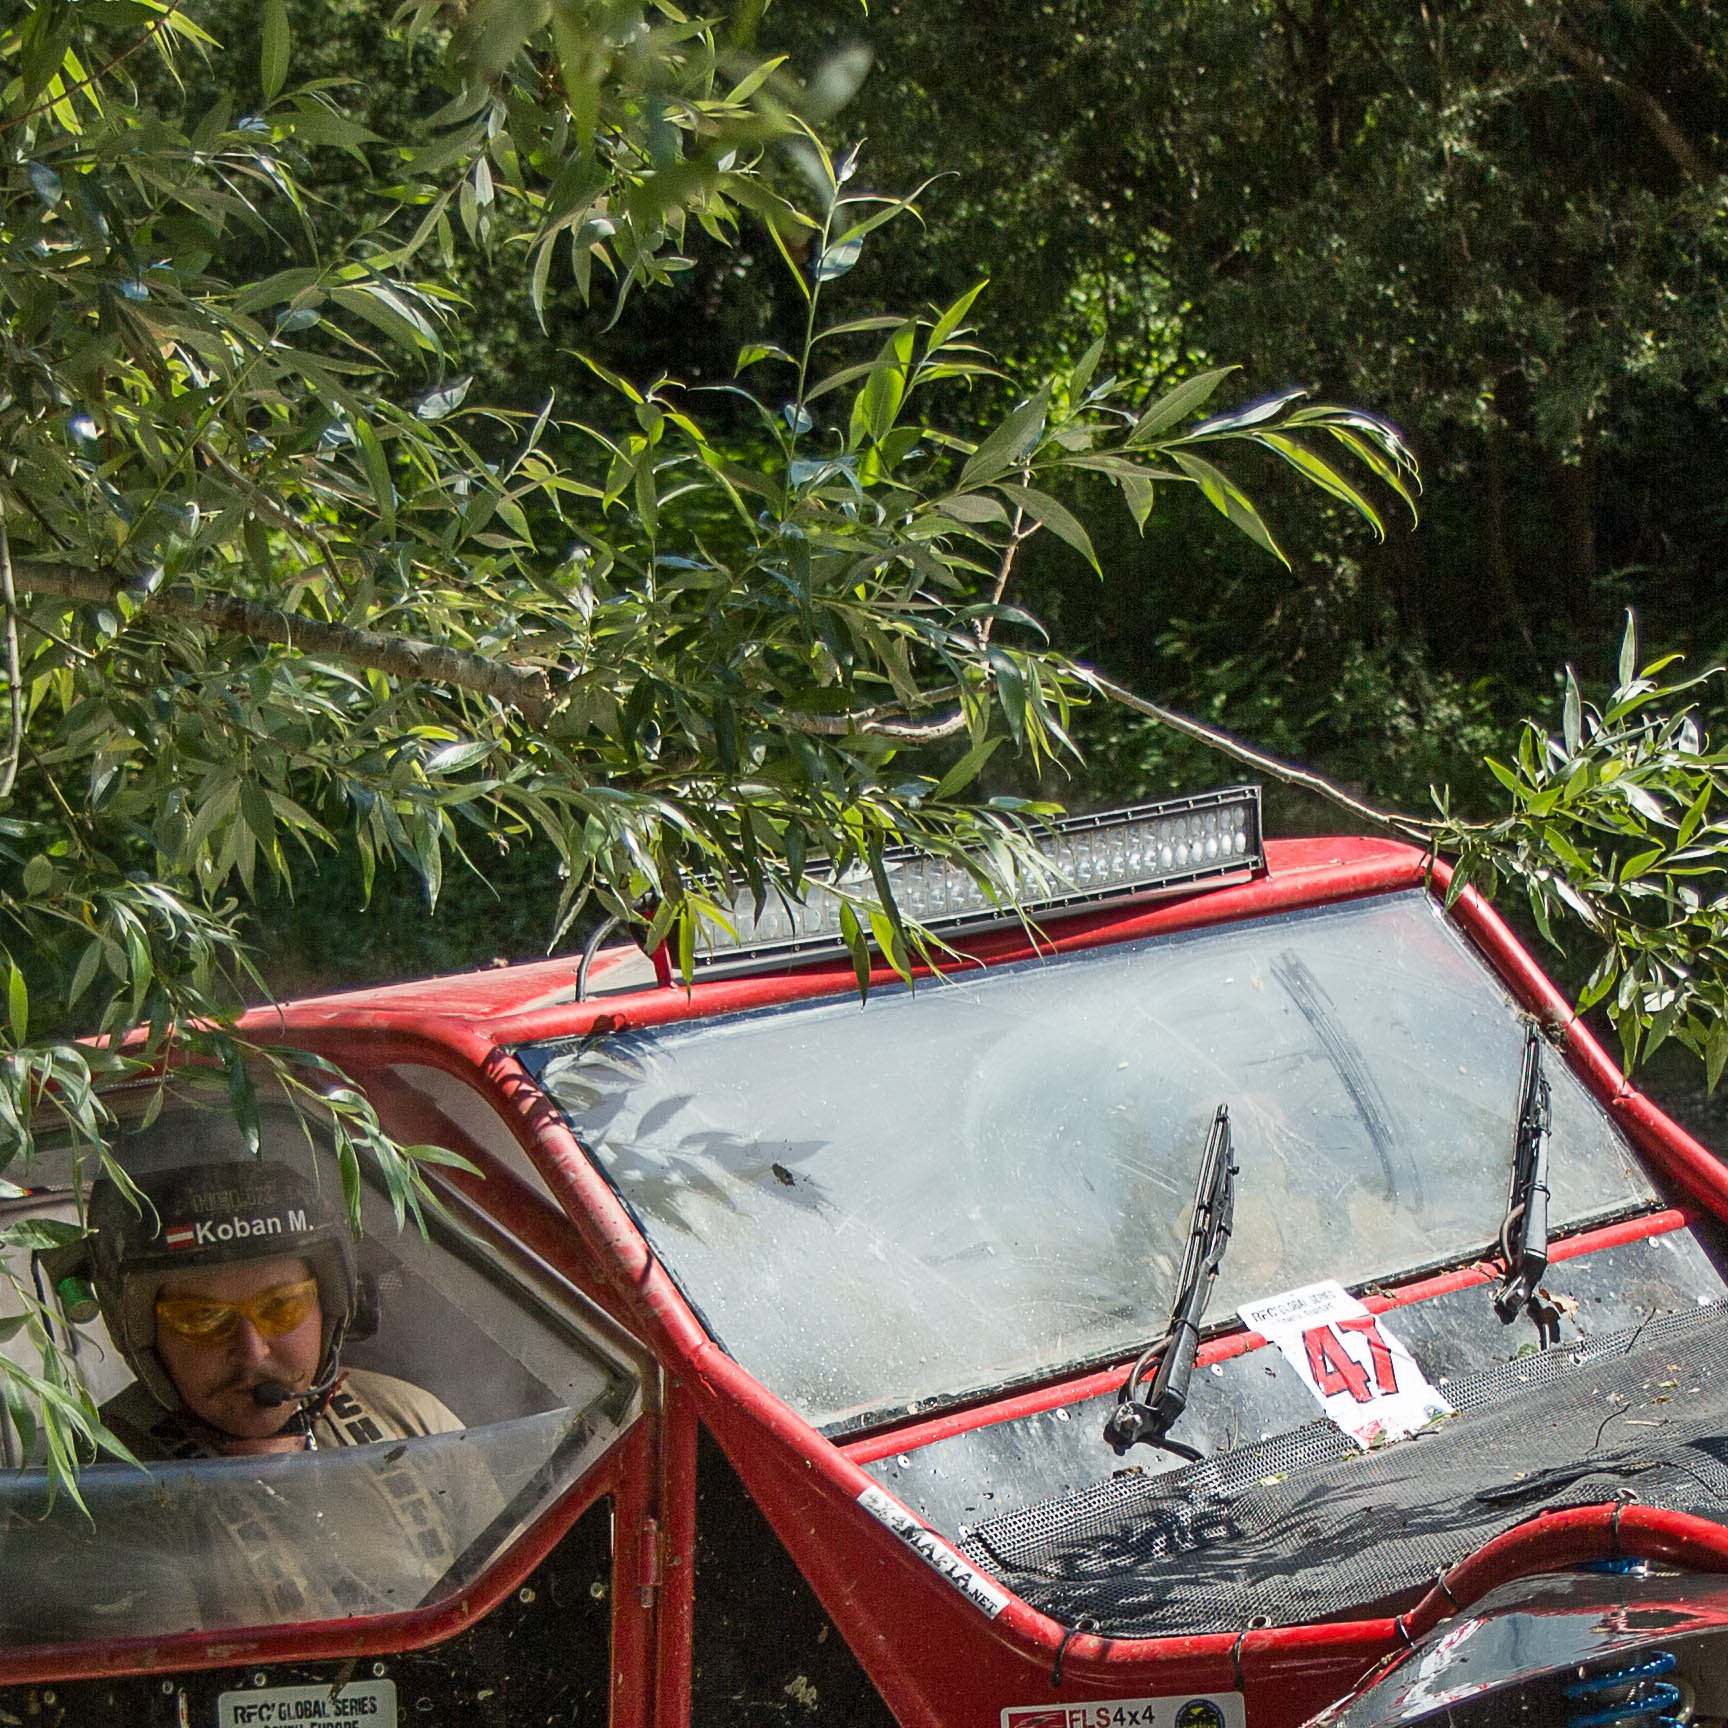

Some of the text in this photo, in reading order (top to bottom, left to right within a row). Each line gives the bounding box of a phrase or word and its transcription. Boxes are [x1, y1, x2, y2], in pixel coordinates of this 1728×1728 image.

[195, 1209, 314, 1244] Koban M.
[1302, 1315, 1400, 1404] 47
[278, 1699, 330, 1722] GLOBAL
[333, 1695, 378, 1717] SERIES
